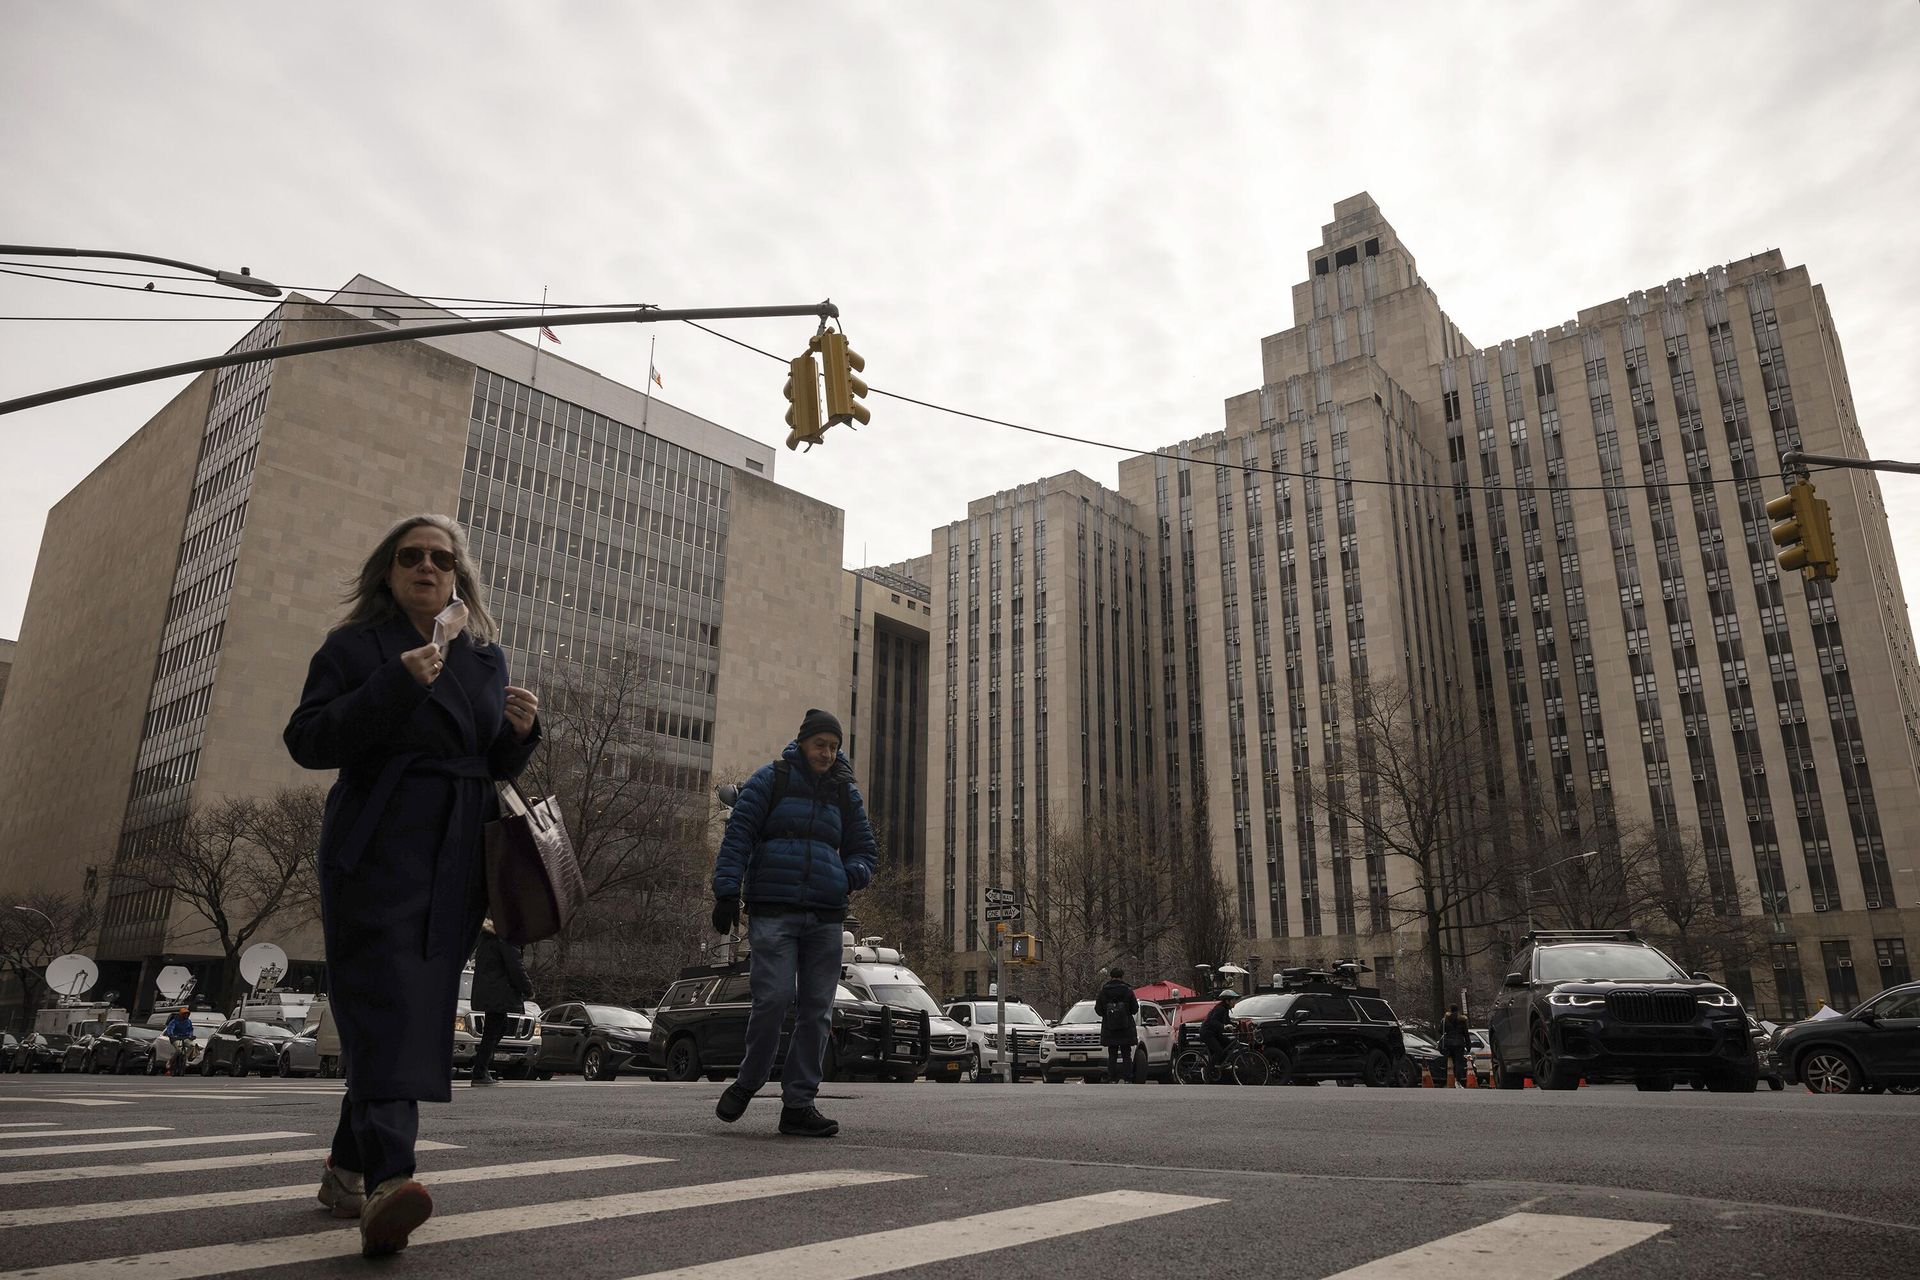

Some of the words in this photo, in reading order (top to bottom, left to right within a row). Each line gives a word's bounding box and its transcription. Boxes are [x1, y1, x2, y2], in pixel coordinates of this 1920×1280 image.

[988, 892, 999, 900] ONE
[988, 910, 999, 918] ONE
[1003, 908, 1016, 916] WAY
